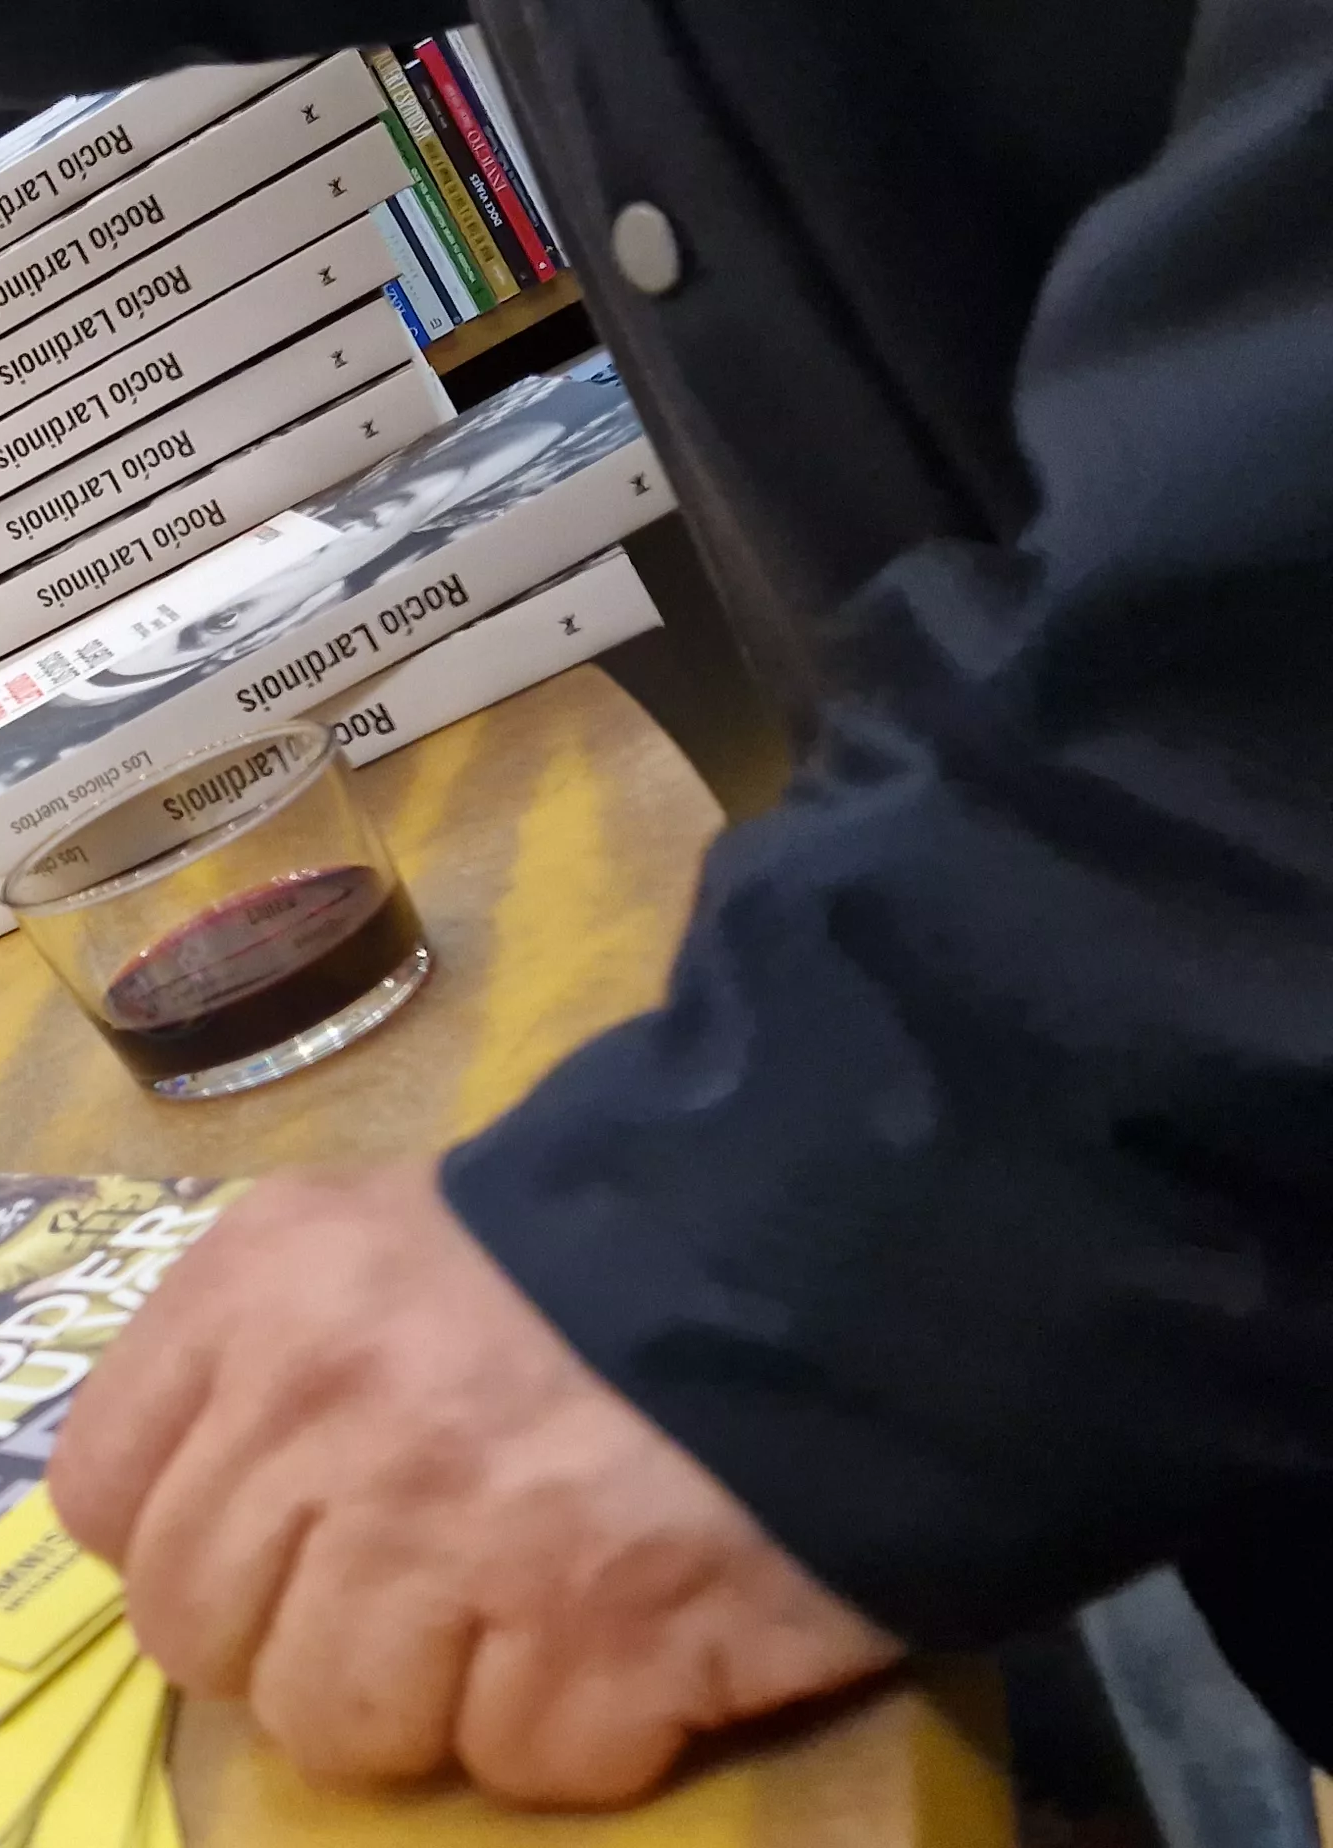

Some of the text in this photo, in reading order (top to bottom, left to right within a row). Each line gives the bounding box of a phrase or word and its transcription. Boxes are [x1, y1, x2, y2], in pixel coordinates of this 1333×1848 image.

[59, 124, 134, 182] Rocío
[463, 127, 509, 193] INVICTO
[89, 193, 166, 252] Rocío
[467, 171, 504, 227] DOCE VIAJES
[116, 264, 192, 322] Rocío
[108, 352, 184, 412] Rocío
[5, 430, 197, 541] Rocío Lardinois
[36, 499, 227, 609] Rocío Lardinois
[381, 572, 469, 637] Rocío
[236, 621, 380, 716] Lardinois
[10, 750, 154, 836] Los chicos tuertos
[162, 744, 290, 822] Lardinois
